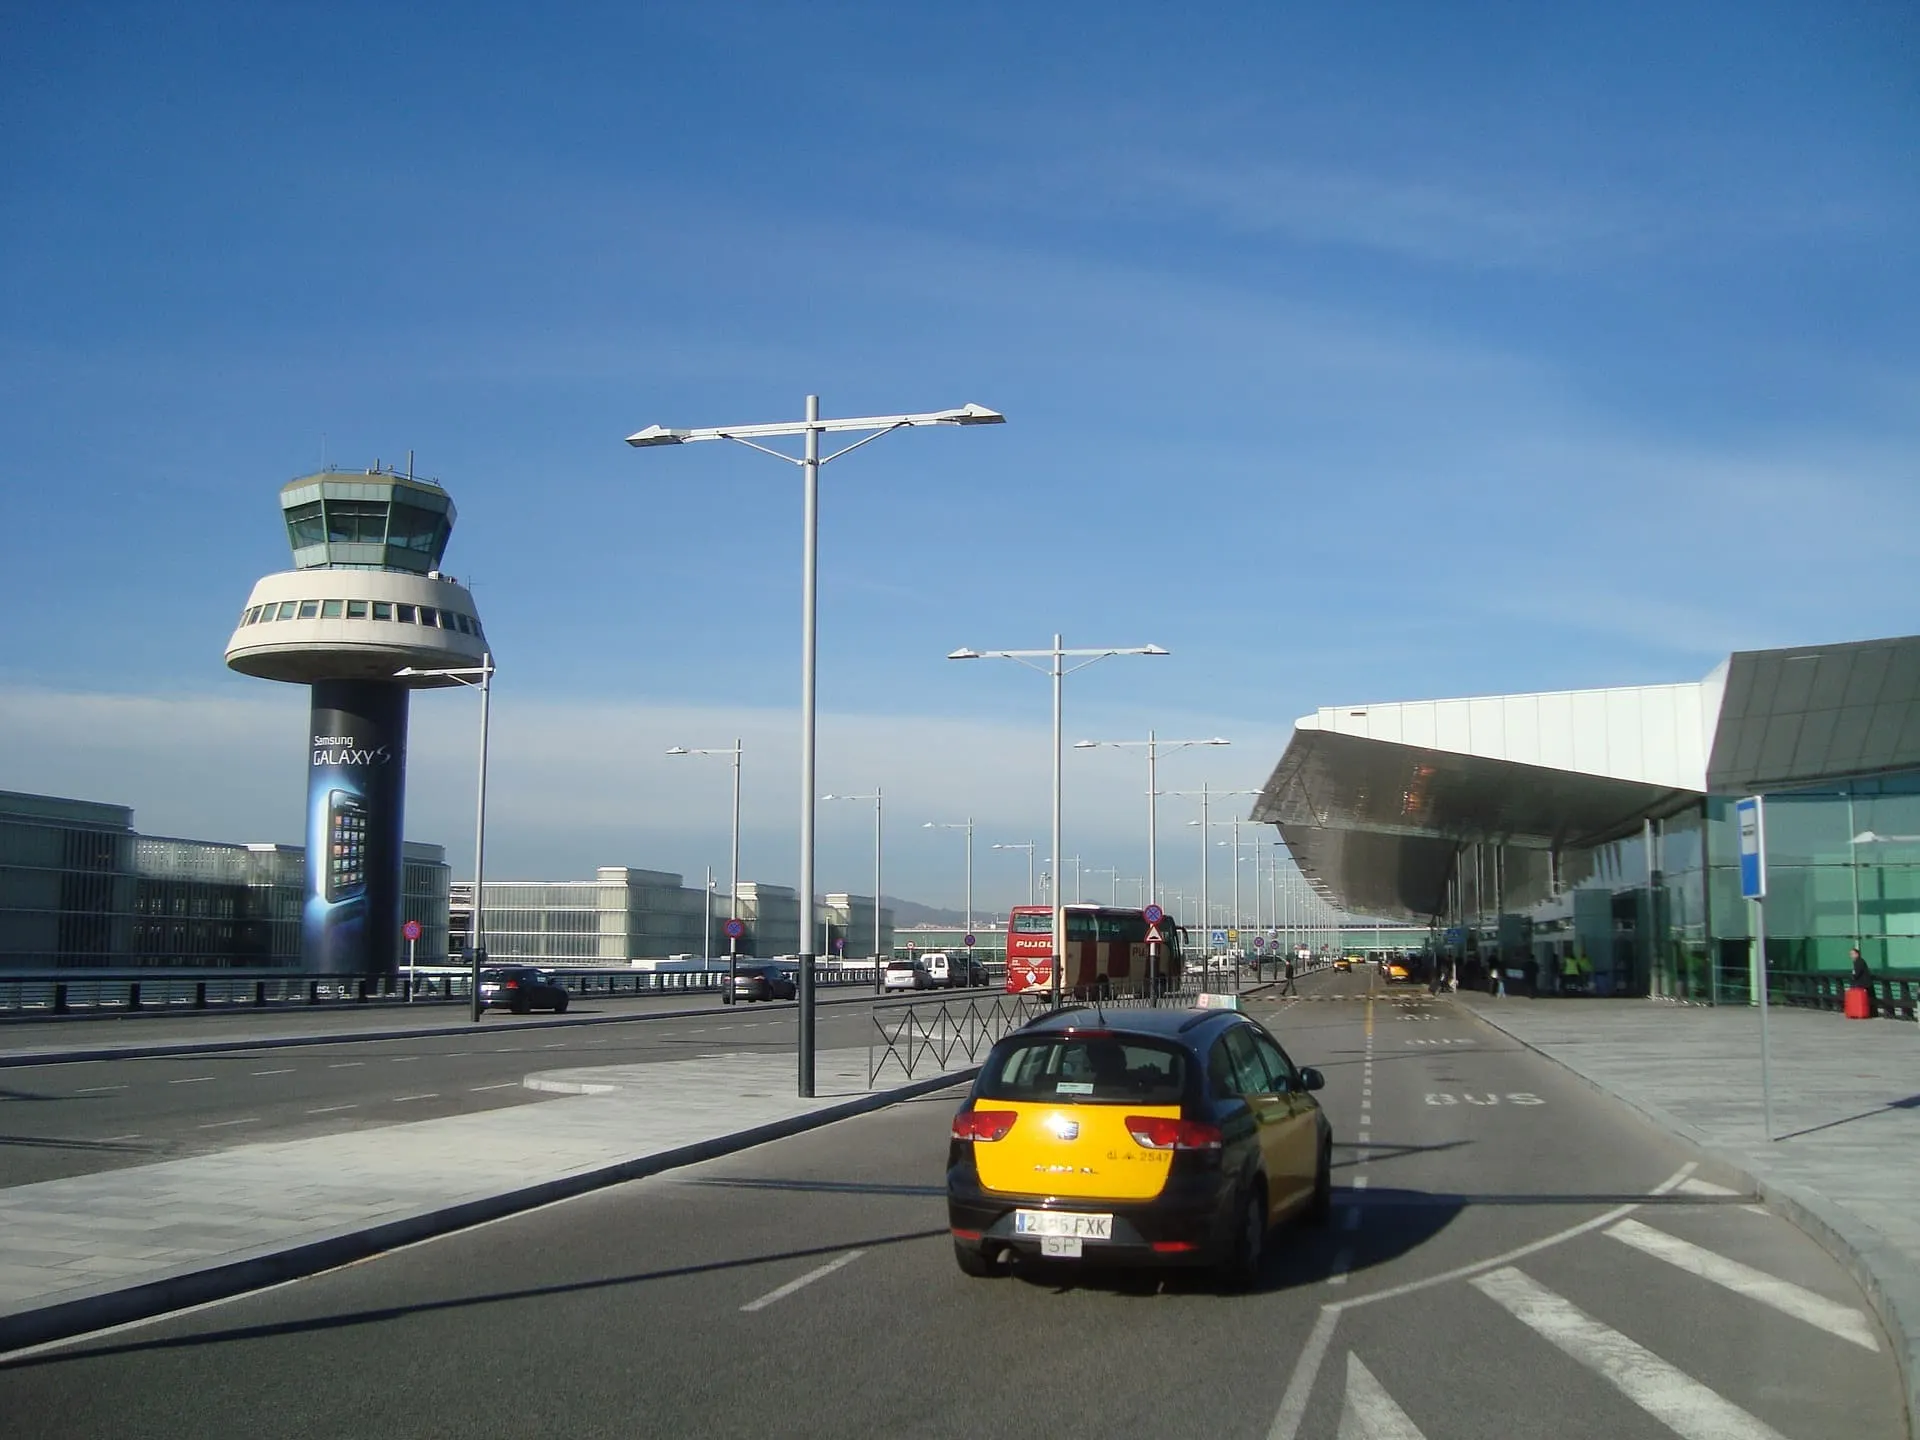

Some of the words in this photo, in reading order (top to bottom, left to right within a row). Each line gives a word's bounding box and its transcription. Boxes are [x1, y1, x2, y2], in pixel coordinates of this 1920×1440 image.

[314, 735, 353, 748] Samsung
[314, 750, 375, 766] GALAXY
[1424, 1093, 1546, 1106] BUS
[1048, 1237, 1076, 1254] SP
